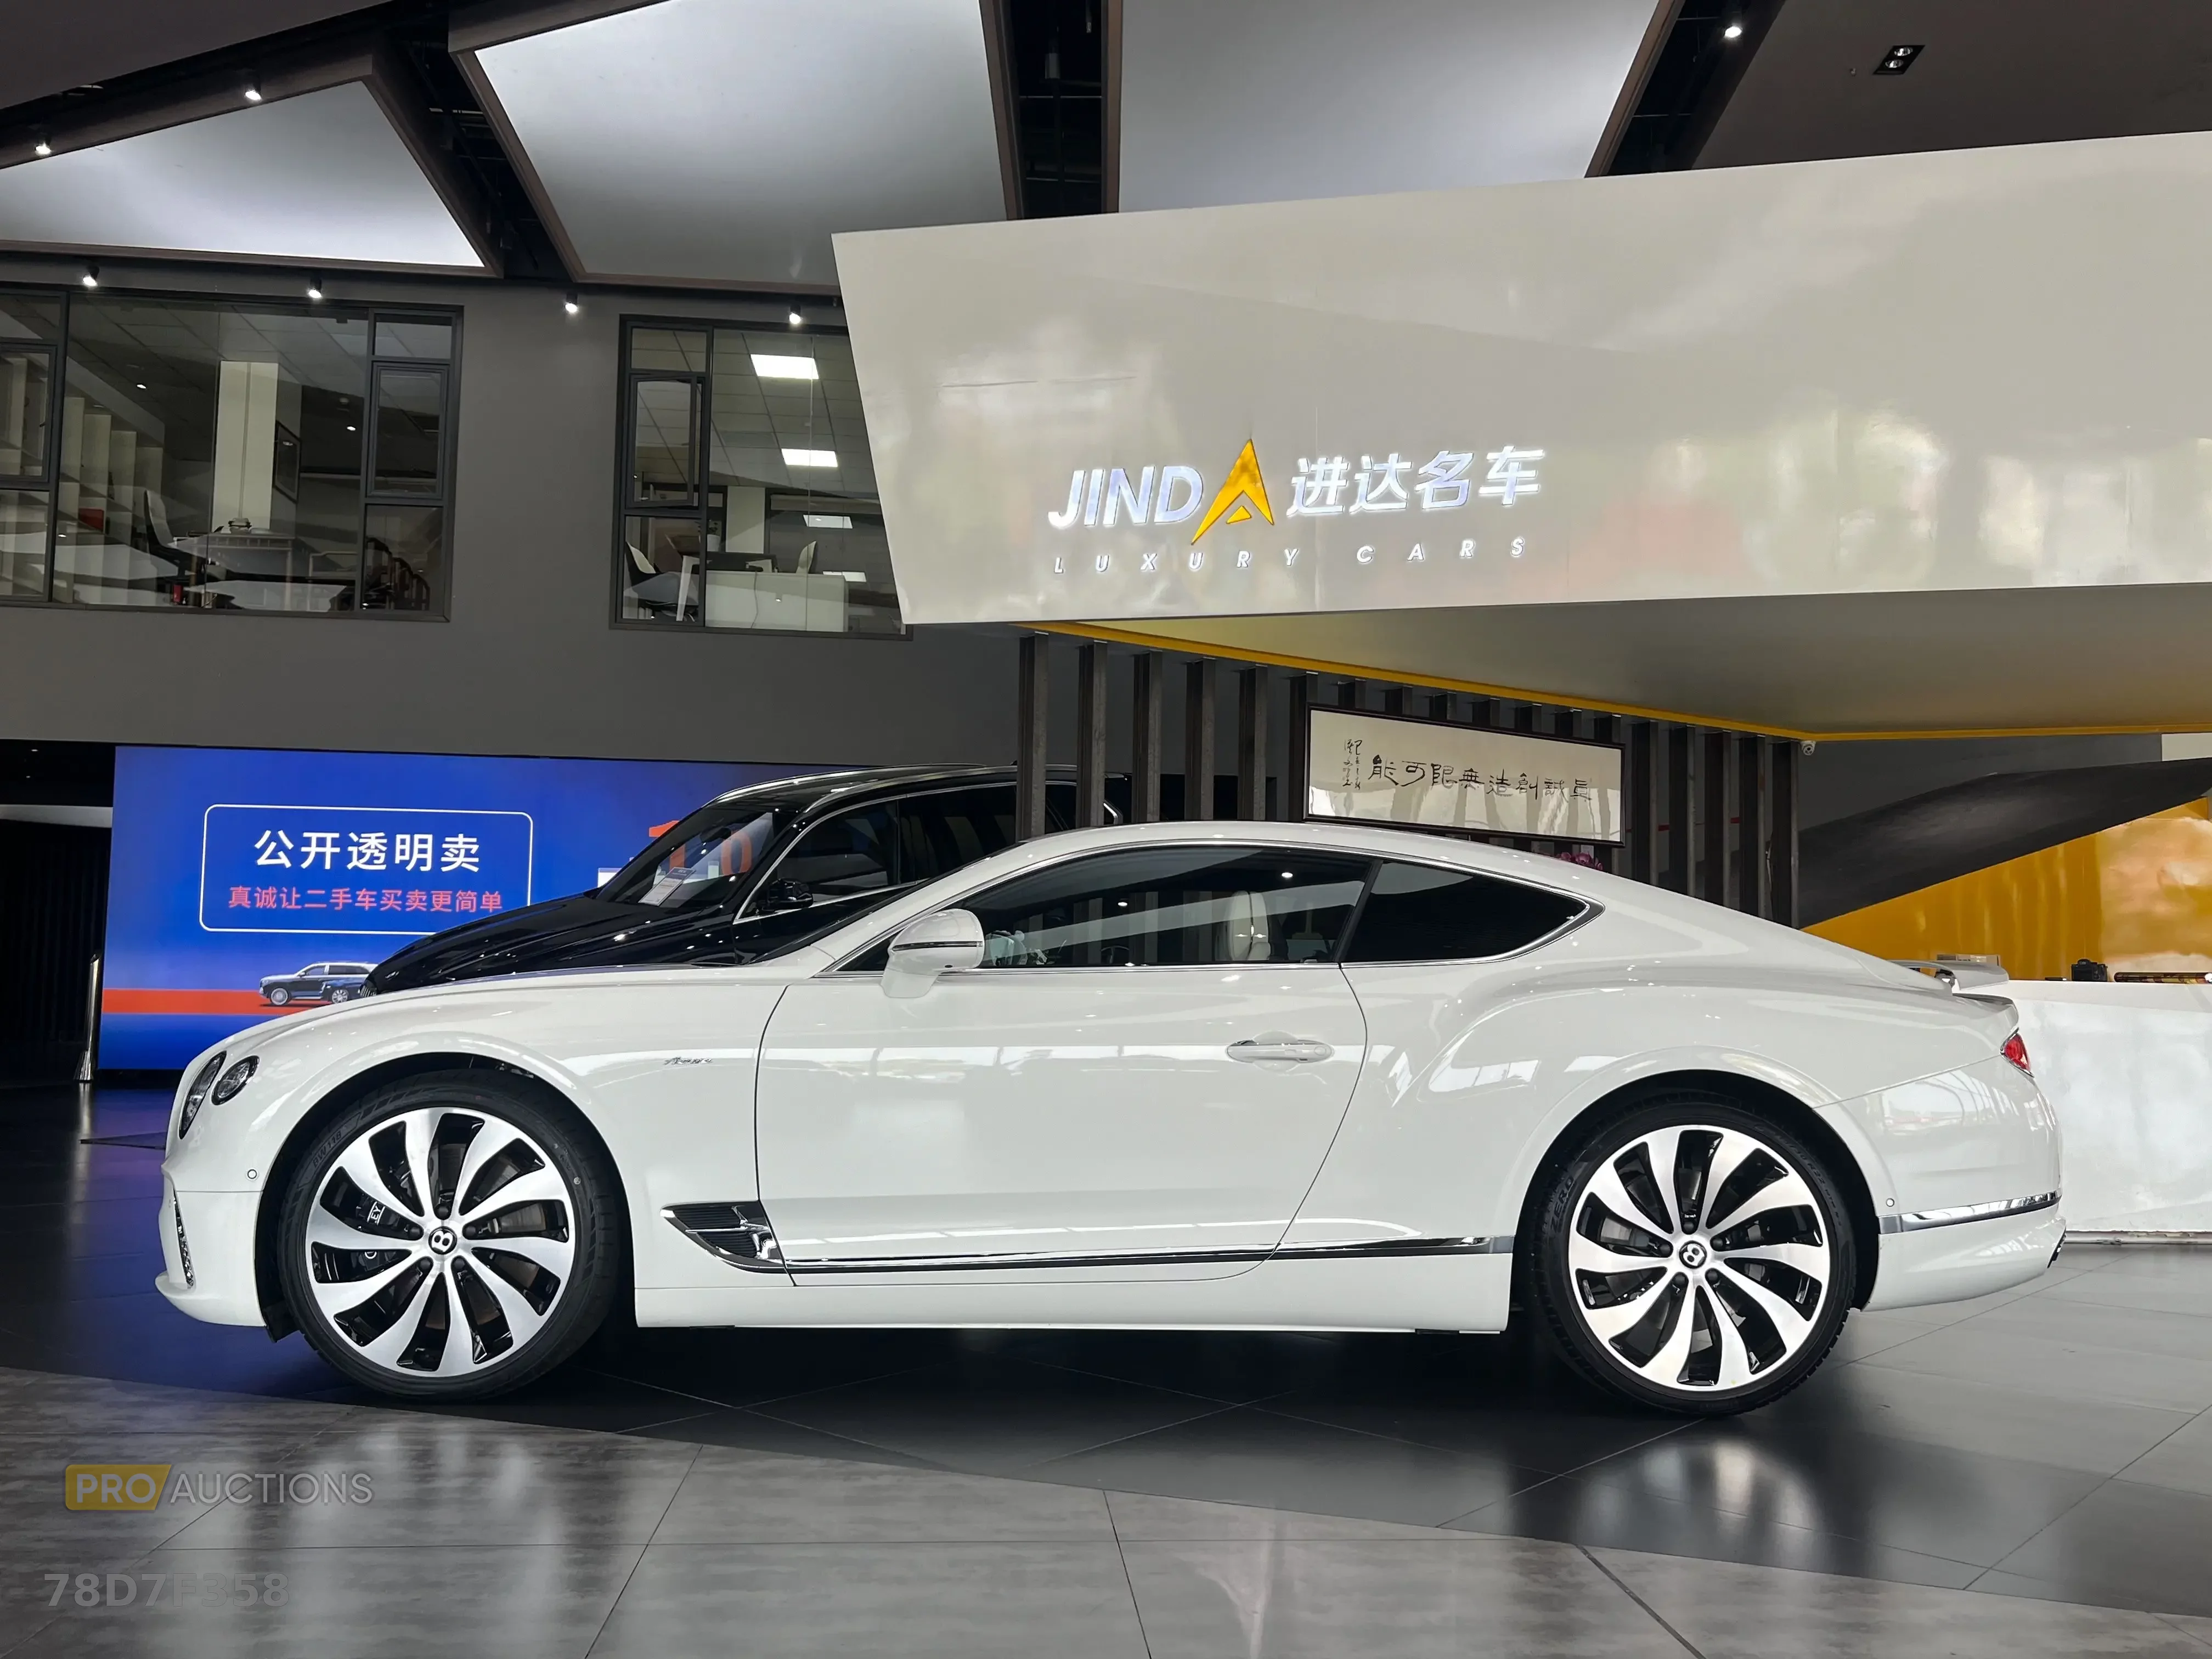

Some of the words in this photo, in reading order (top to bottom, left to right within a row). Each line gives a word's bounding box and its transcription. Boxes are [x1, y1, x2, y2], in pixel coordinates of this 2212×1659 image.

[1286, 445, 1544, 516] 进达名车
[1054, 549, 1299, 574] LUXURY
[1356, 537, 1525, 563] CARS
[254, 829, 480, 873] 公开透明卖
[228, 885, 503, 913] 真诚让二手车买卖更简单
